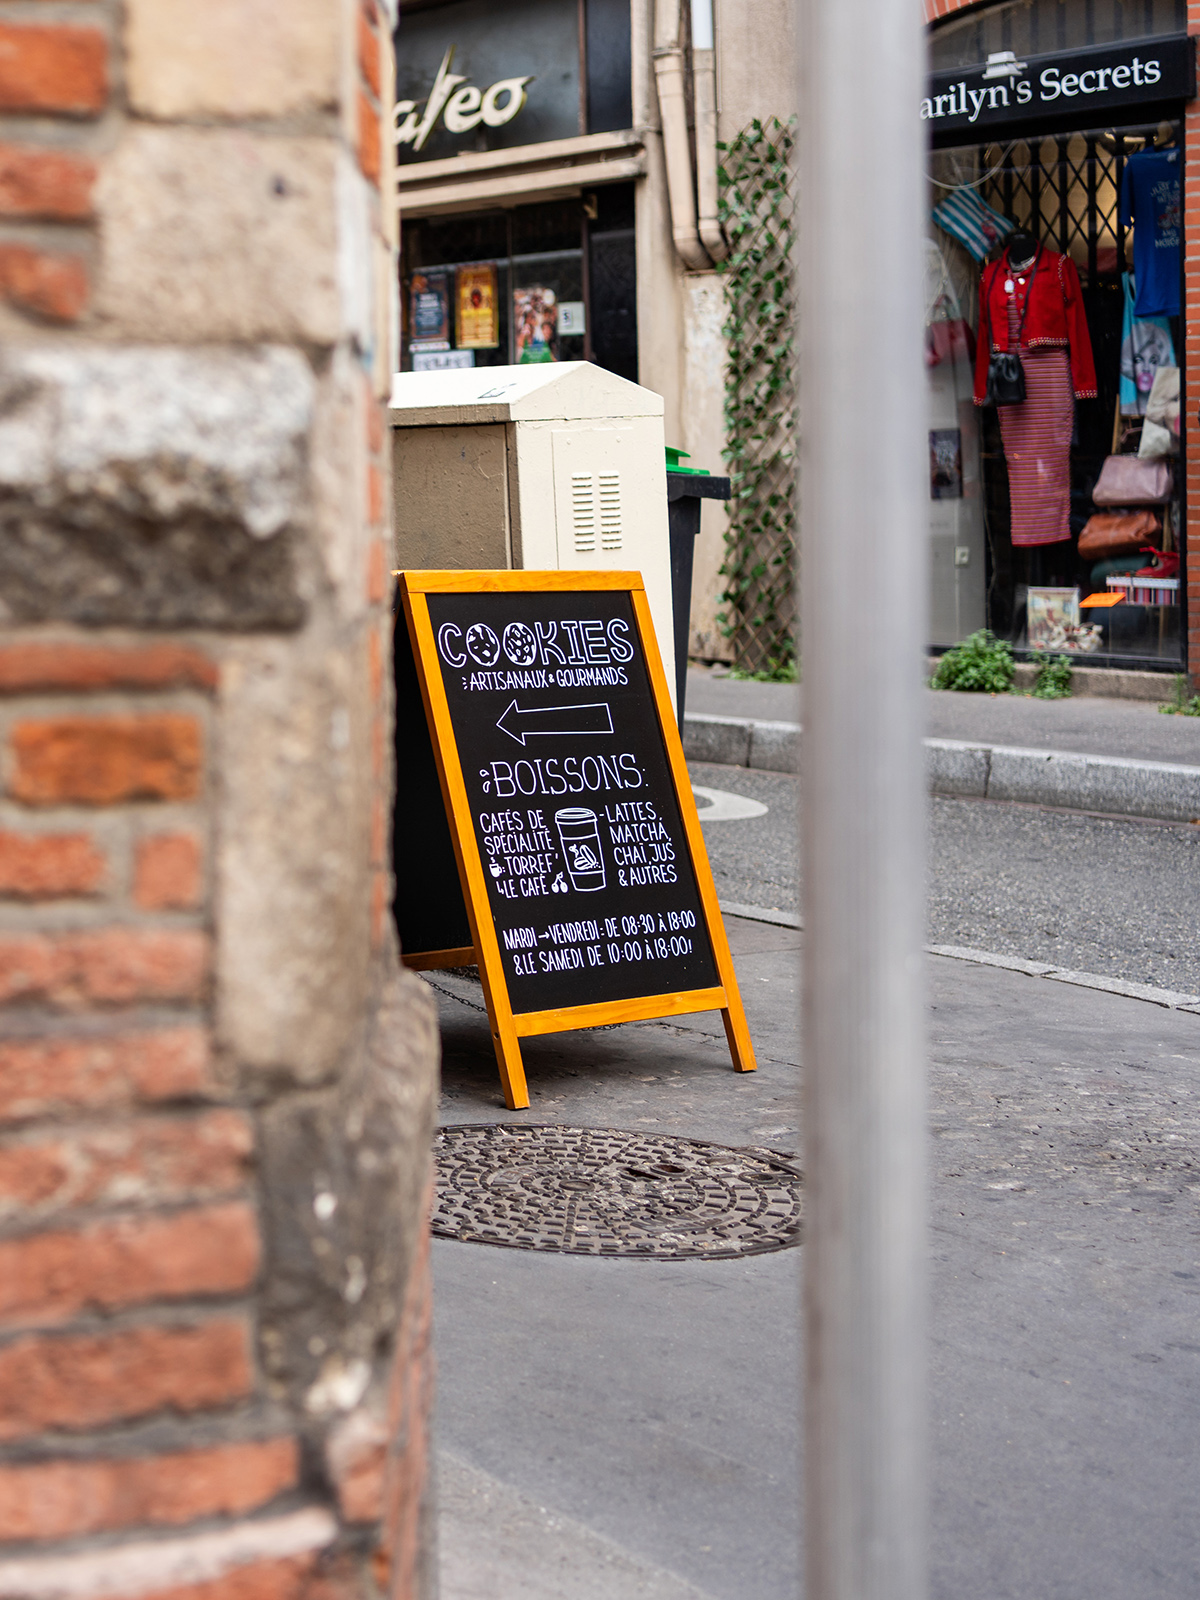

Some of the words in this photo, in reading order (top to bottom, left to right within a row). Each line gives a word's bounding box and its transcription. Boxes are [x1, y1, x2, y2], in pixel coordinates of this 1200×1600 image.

[919, 76, 1033, 123] arilyn's
[1039, 57, 1161, 101] Secrets
[437, 617, 634, 668] COOKIES
[469, 669, 550, 692] ARTISANAUX
[555, 666, 629, 688] GOURMANDS
[479, 808, 524, 834] CAFÉS
[526, 809, 547, 830] DE
[648, 841, 676, 863] JUS
[502, 880, 519, 899] LE
[519, 873, 550, 898] CAFÉ
[629, 863, 678, 887] AUTRES
[502, 926, 538, 950] MARDI
[604, 917, 621, 938] DE
[621, 913, 656, 936] 08:30
[657, 912, 668, 933] À
[666, 909, 697, 932] 18:00
[538, 947, 585, 973] SAMEDI
[586, 944, 605, 967] DE
[606, 940, 643, 964] 10:00
[644, 938, 655, 960] À
